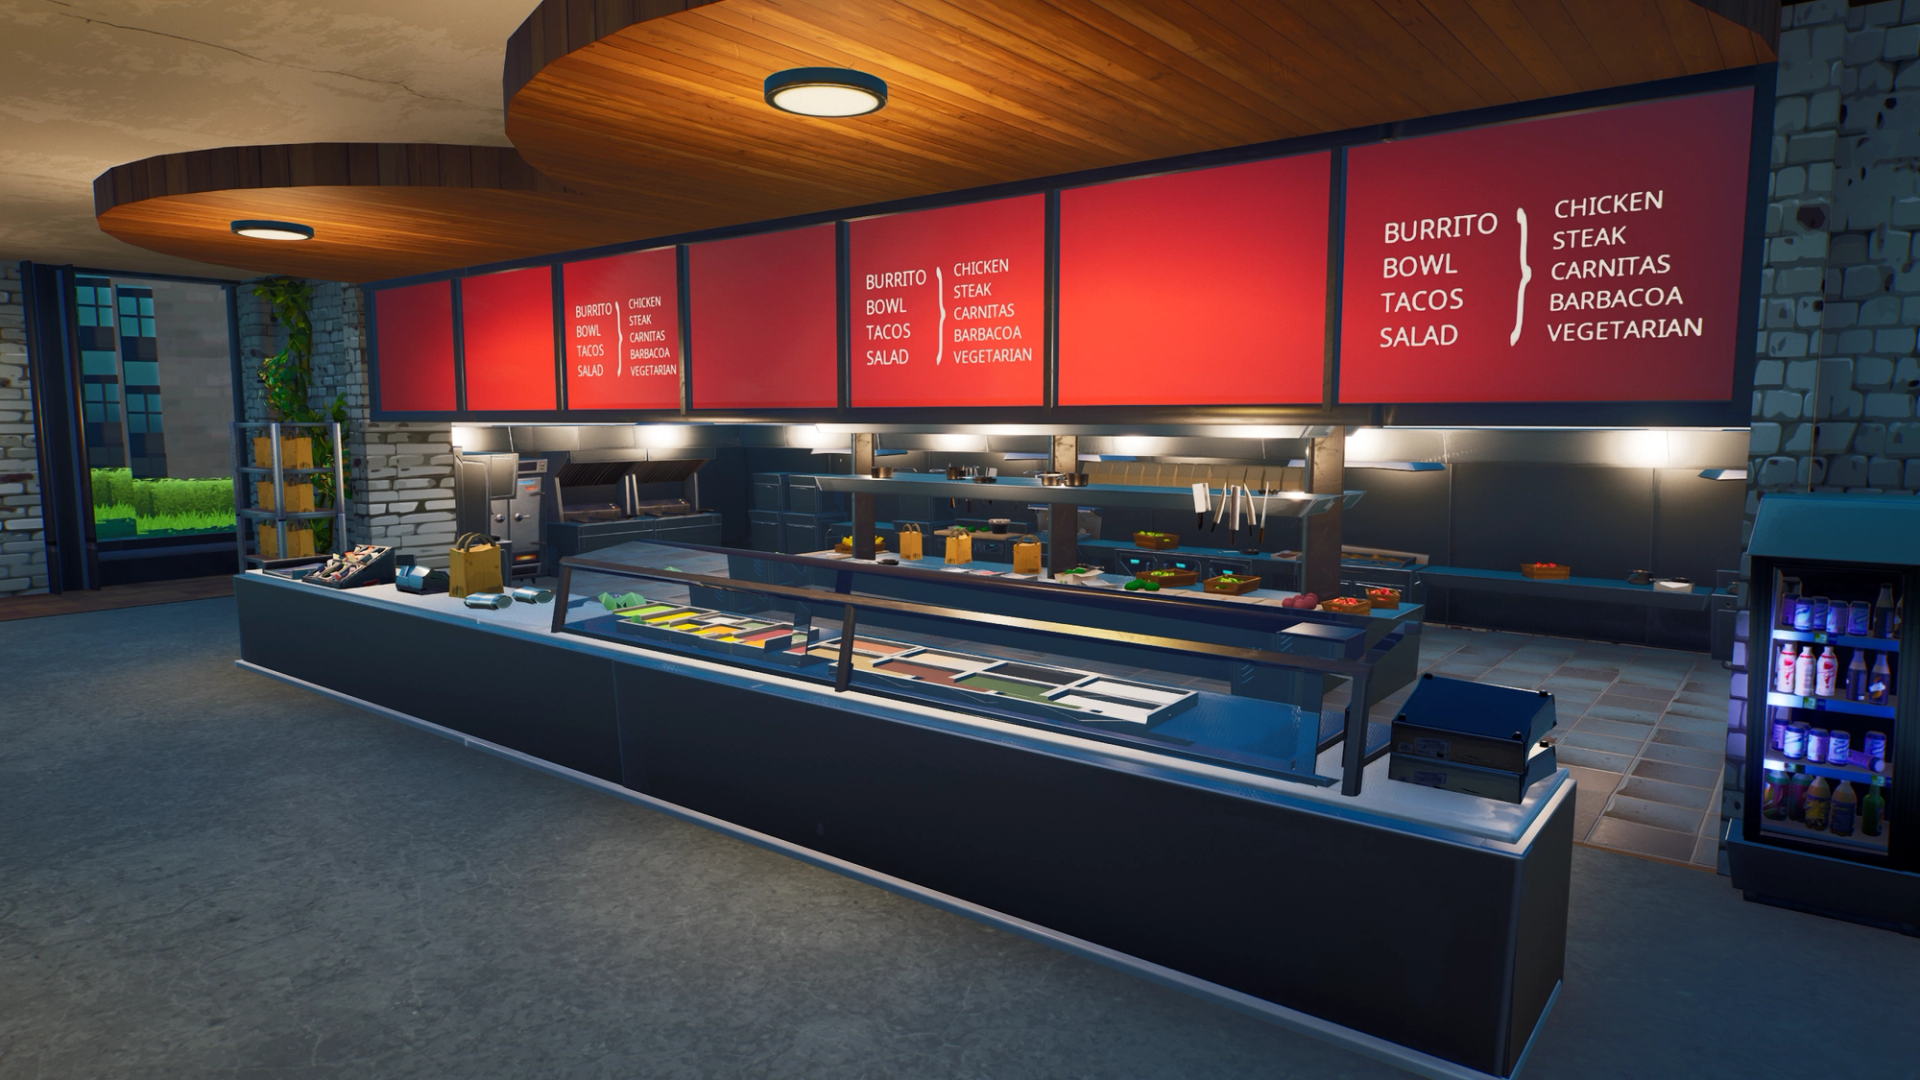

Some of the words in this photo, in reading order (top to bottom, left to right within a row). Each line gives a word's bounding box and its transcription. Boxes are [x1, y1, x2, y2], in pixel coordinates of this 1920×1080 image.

[1554, 189, 1665, 219] CHICKEN
[1384, 212, 1498, 244] BURRITO
[1552, 225, 1627, 250] STEAK
[953, 258, 1009, 276] CHICKEN
[1383, 252, 1458, 279] BOWL
[1551, 253, 1671, 281] CARNITAS
[865, 269, 927, 290] BURRITO
[954, 282, 992, 298] STEAK
[1549, 285, 1684, 311] BARBACOA
[628, 296, 661, 309] CHICKEN
[866, 297, 907, 315] BOWL
[1381, 287, 1464, 313] TACOS
[575, 303, 613, 318] BURRITO
[953, 304, 1016, 321] CARNITAS
[629, 314, 652, 326] STEAK
[576, 324, 601, 338] BOWL
[629, 330, 666, 343] CARNITAS
[866, 322, 912, 340] TACOS
[953, 326, 1022, 342] BARBACOA
[1379, 323, 1459, 348] SALAD
[1547, 317, 1704, 343] VEGETARIAN
[577, 344, 604, 357] TACOS
[630, 347, 670, 360] BARBACOA
[866, 348, 910, 365] SALAD
[953, 347, 1033, 363] VEGETARIAN
[578, 364, 604, 377] SALAD
[630, 364, 677, 377] VEGETARIAN
